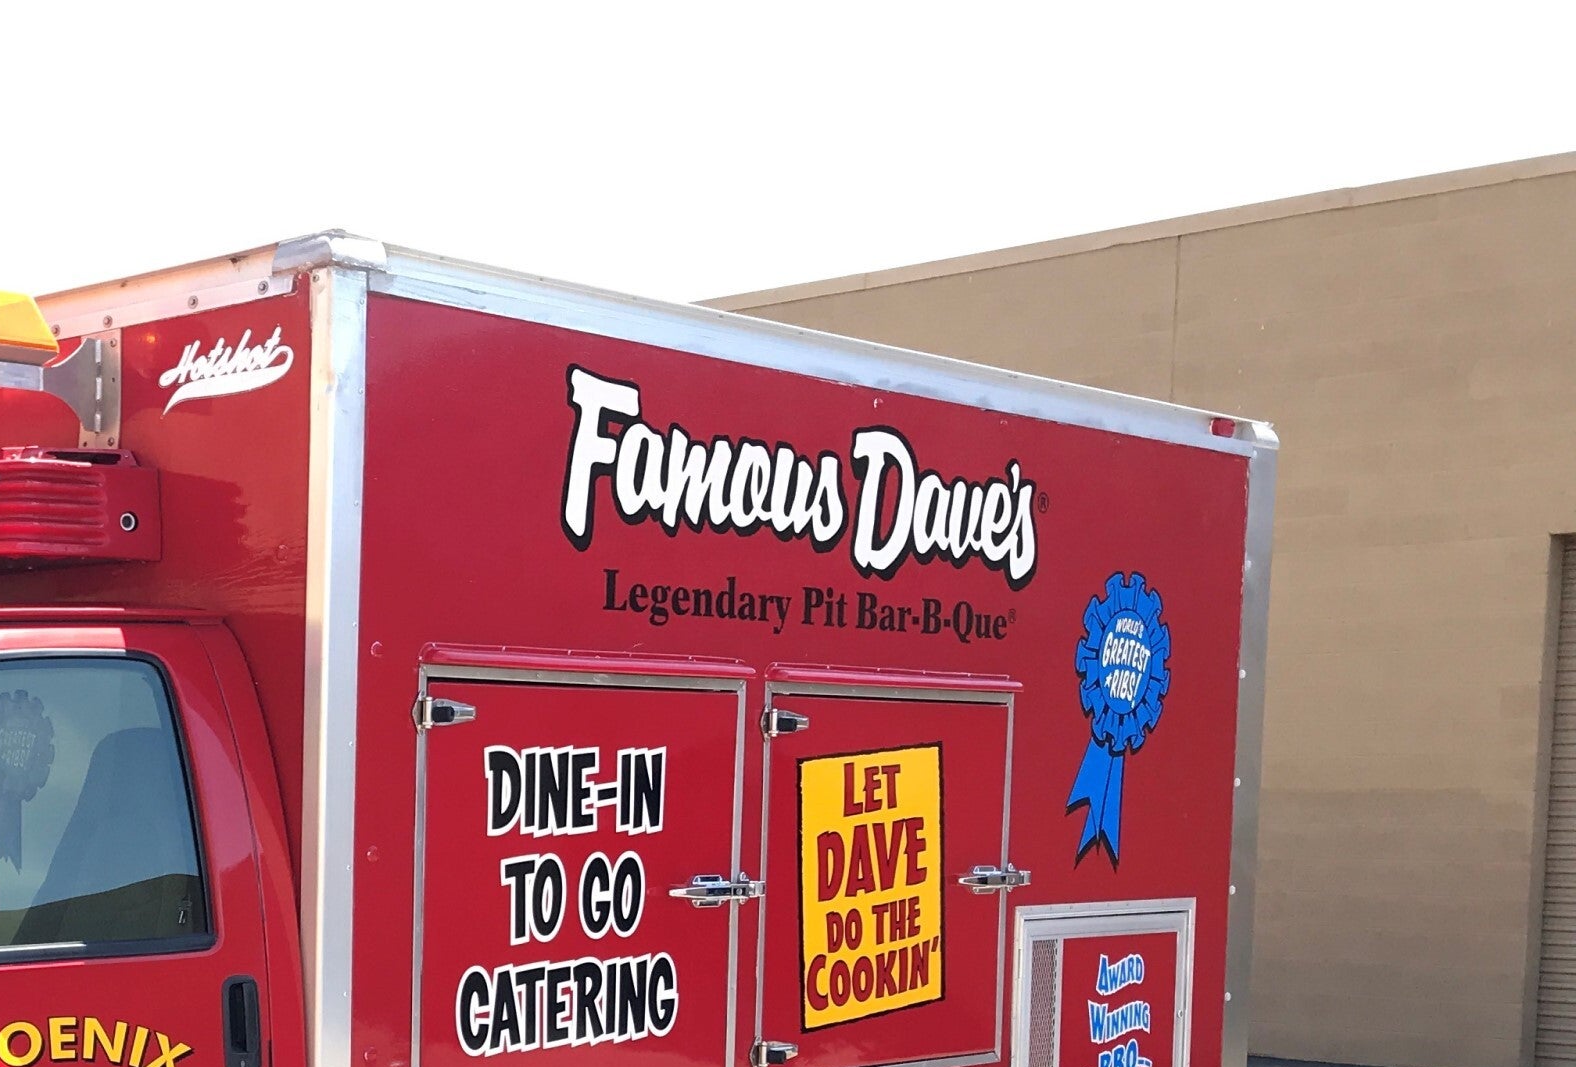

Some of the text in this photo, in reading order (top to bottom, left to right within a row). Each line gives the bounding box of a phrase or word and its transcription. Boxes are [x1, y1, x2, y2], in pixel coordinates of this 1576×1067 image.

[561, 363, 1037, 590] Famous Dave's
[603, 568, 791, 634] Legendary
[801, 586, 848, 628] Pit
[1115, 617, 1145, 639] WORLD'S
[1101, 632, 1151, 673] GREATEST
[484, 745, 667, 838] DINE-IN
[843, 762, 901, 817] LET
[816, 817, 927, 902] DAVE
[500, 851, 645, 945] TO GO
[826, 896, 921, 953] DO THE
[456, 952, 679, 1057] CATERING
[806, 935, 940, 1011] COOKIN'
[1096, 954, 1145, 996] AWARD
[1088, 999, 1151, 1044] WINNING
